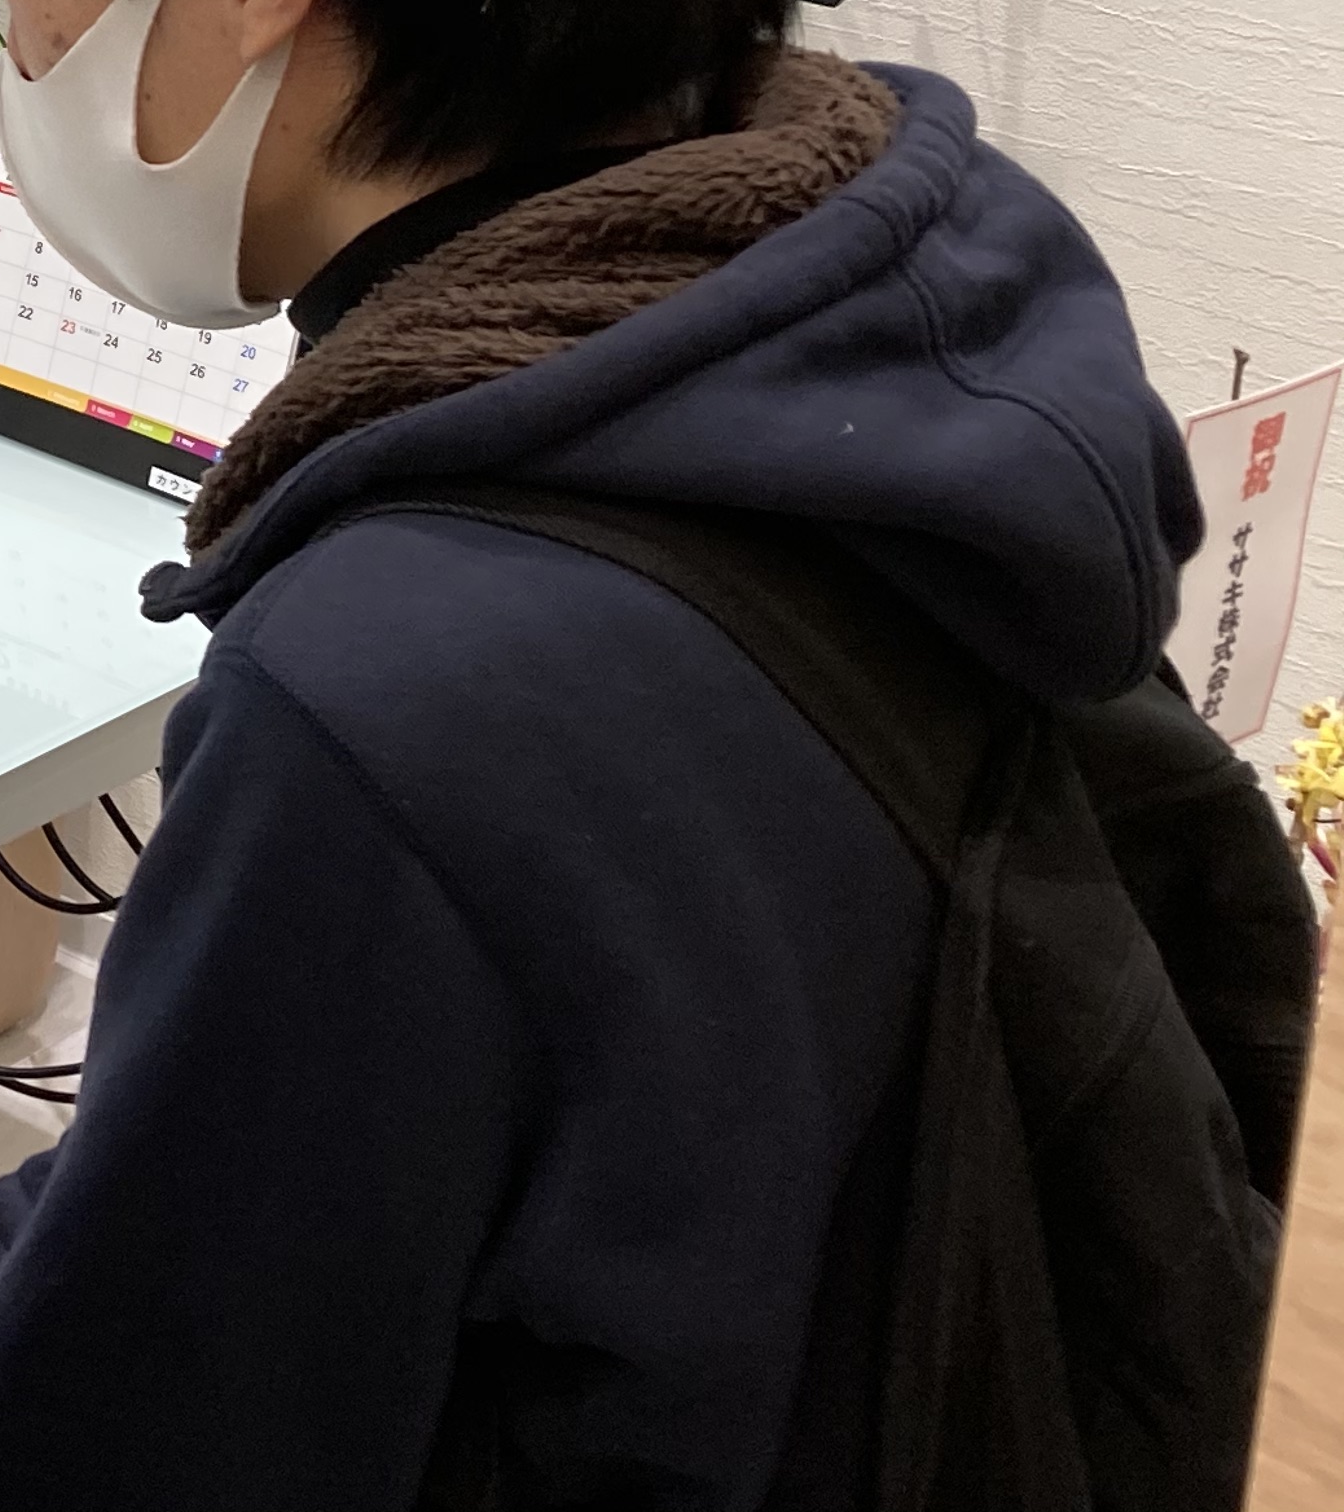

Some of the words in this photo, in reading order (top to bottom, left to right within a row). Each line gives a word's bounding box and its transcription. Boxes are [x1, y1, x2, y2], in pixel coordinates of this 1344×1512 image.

[34, 241, 44, 255] 8
[18, 305, 34, 321] 22
[60, 319, 76, 335] 23
[103, 333, 119, 349] 24
[146, 347, 162, 364] 25
[189, 363, 206, 379] 26
[232, 378, 249, 393] 27
[25, 273, 40, 287] 15
[68, 287, 82, 302] 16
[111, 301, 126, 315] 17
[198, 330, 212, 345] 19
[240, 344, 257, 360] 20
[155, 474, 199, 496] カウン
[1200, 521, 1254, 720] ササキ株式会社
